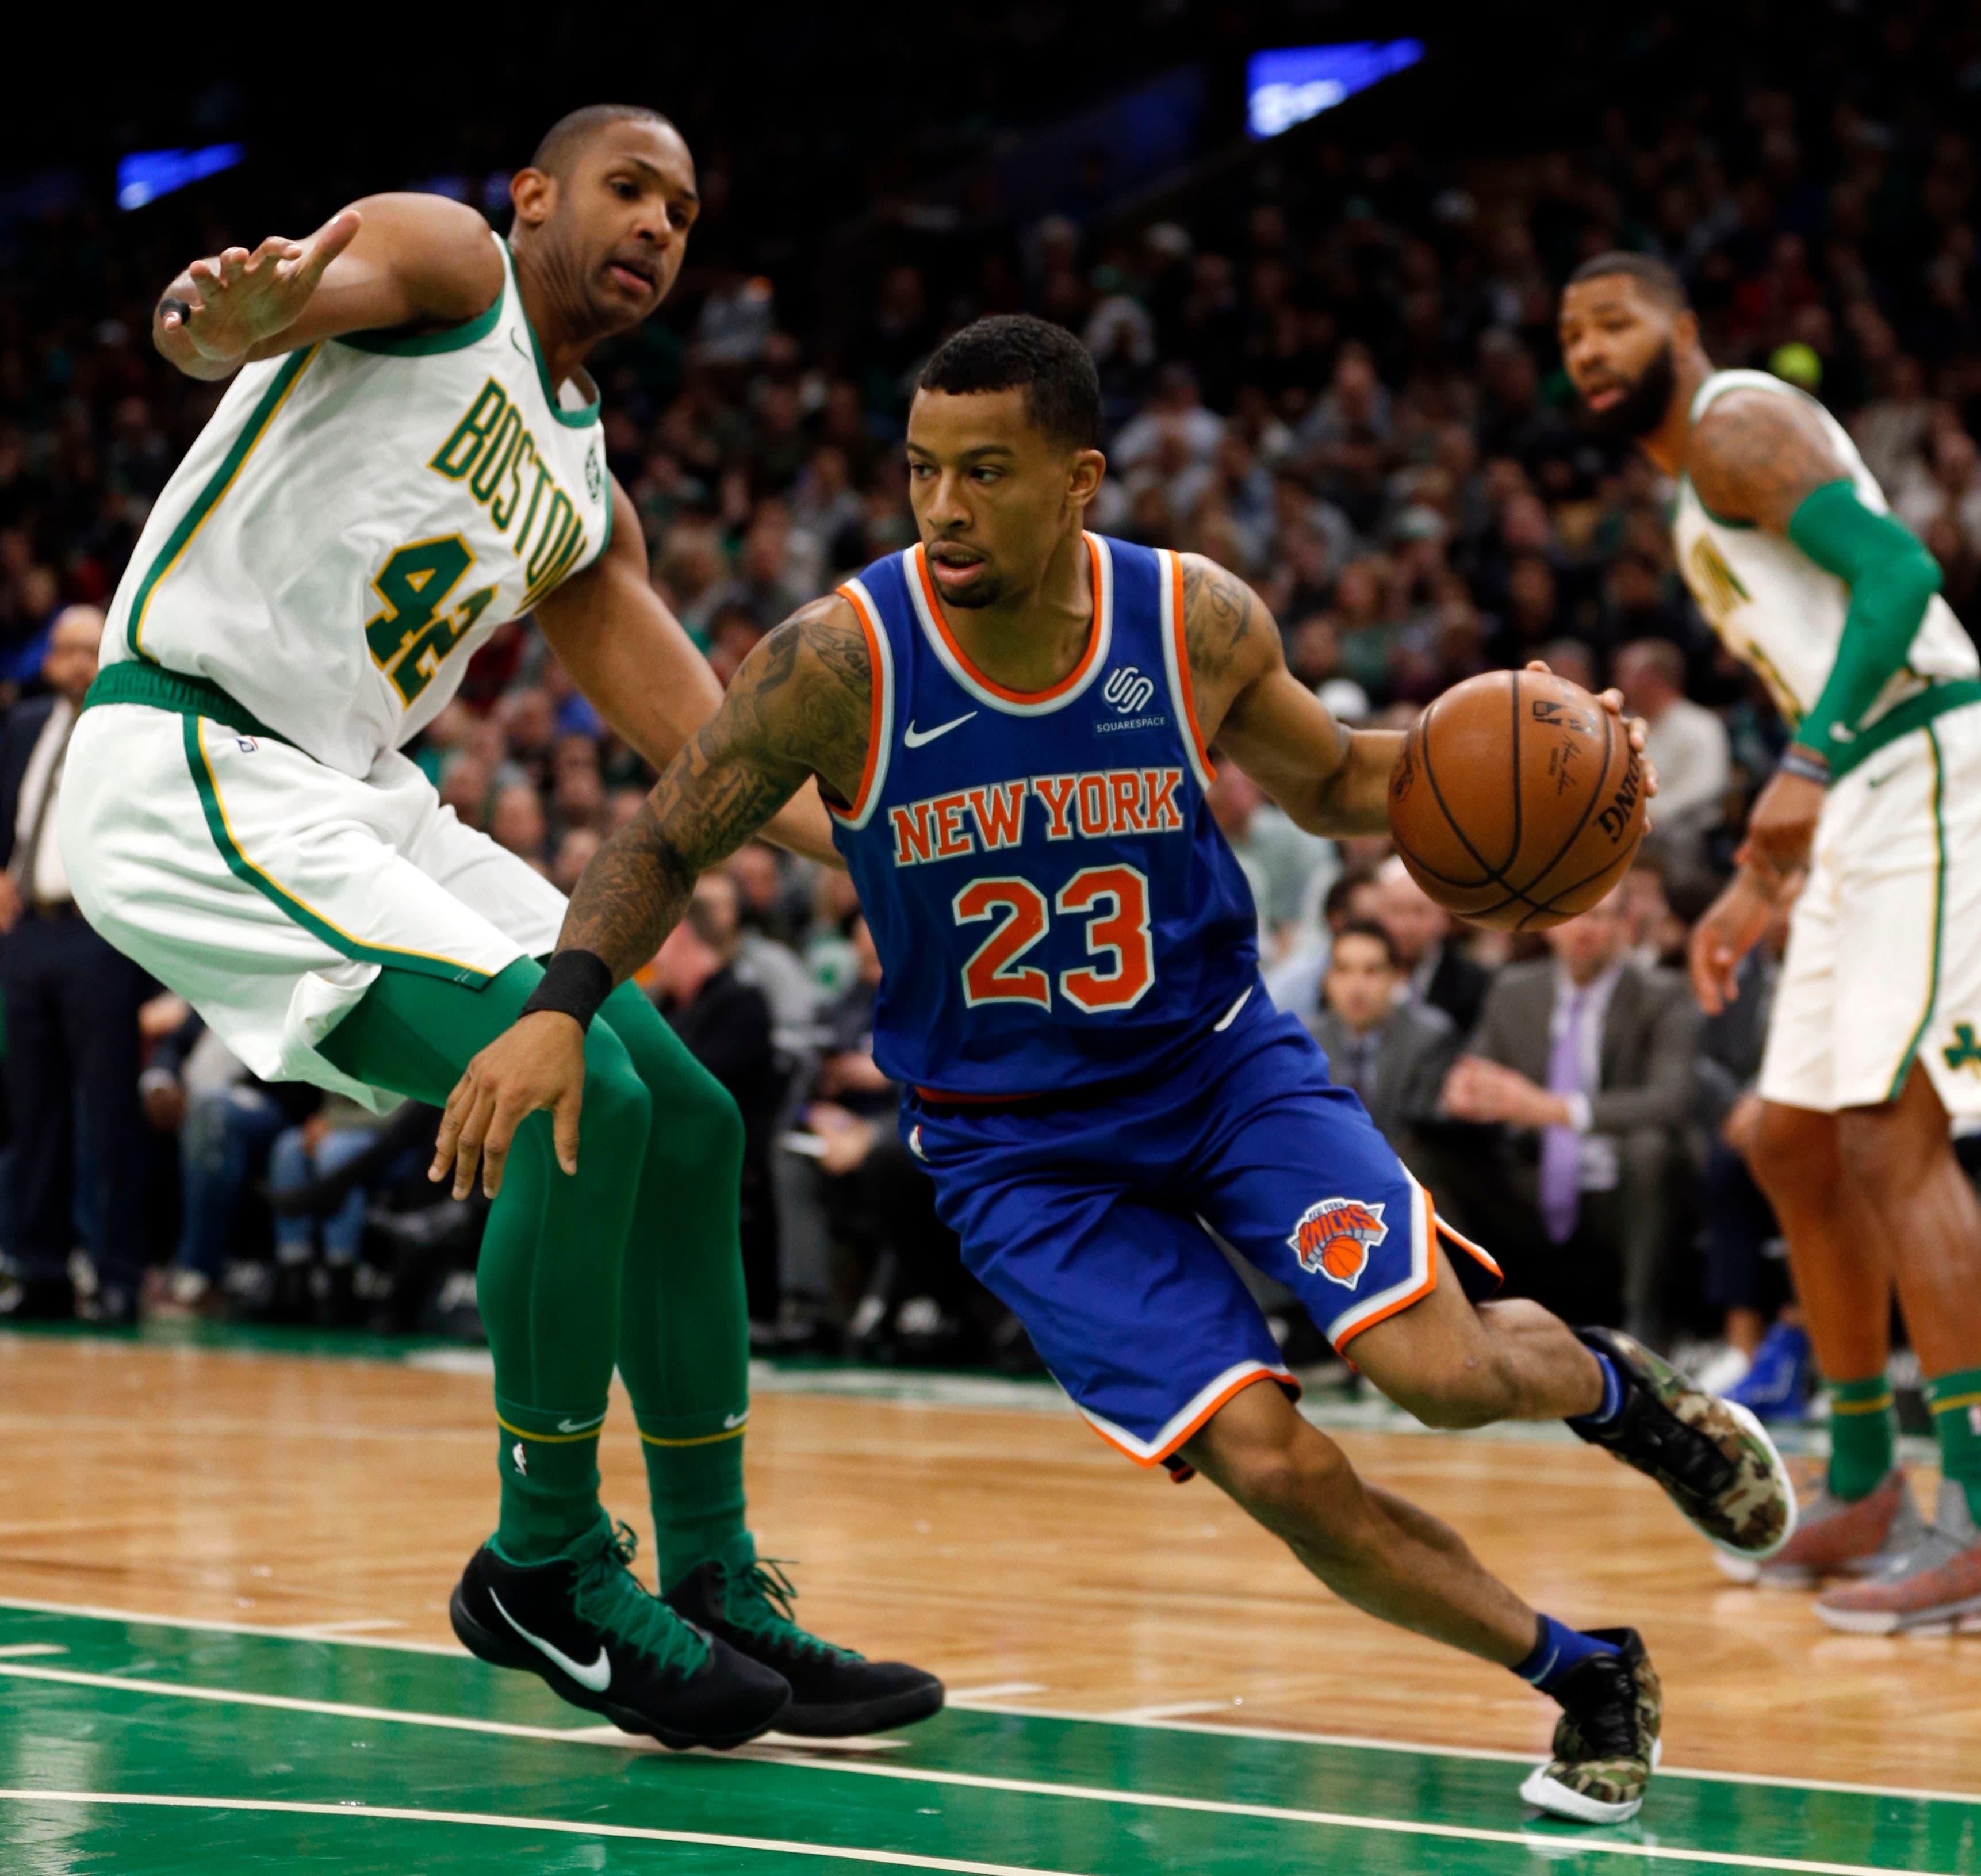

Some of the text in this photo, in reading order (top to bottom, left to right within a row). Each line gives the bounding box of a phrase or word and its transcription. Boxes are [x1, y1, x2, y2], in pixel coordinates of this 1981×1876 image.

[427, 376, 588, 615] BOSTON
[365, 532, 498, 710] 42
[1097, 717, 1166, 733] SQUARESPACE
[888, 767, 1185, 867] NEW YORK
[952, 863, 1155, 1014] 23
[1298, 1204, 1383, 1264] KNICKS
